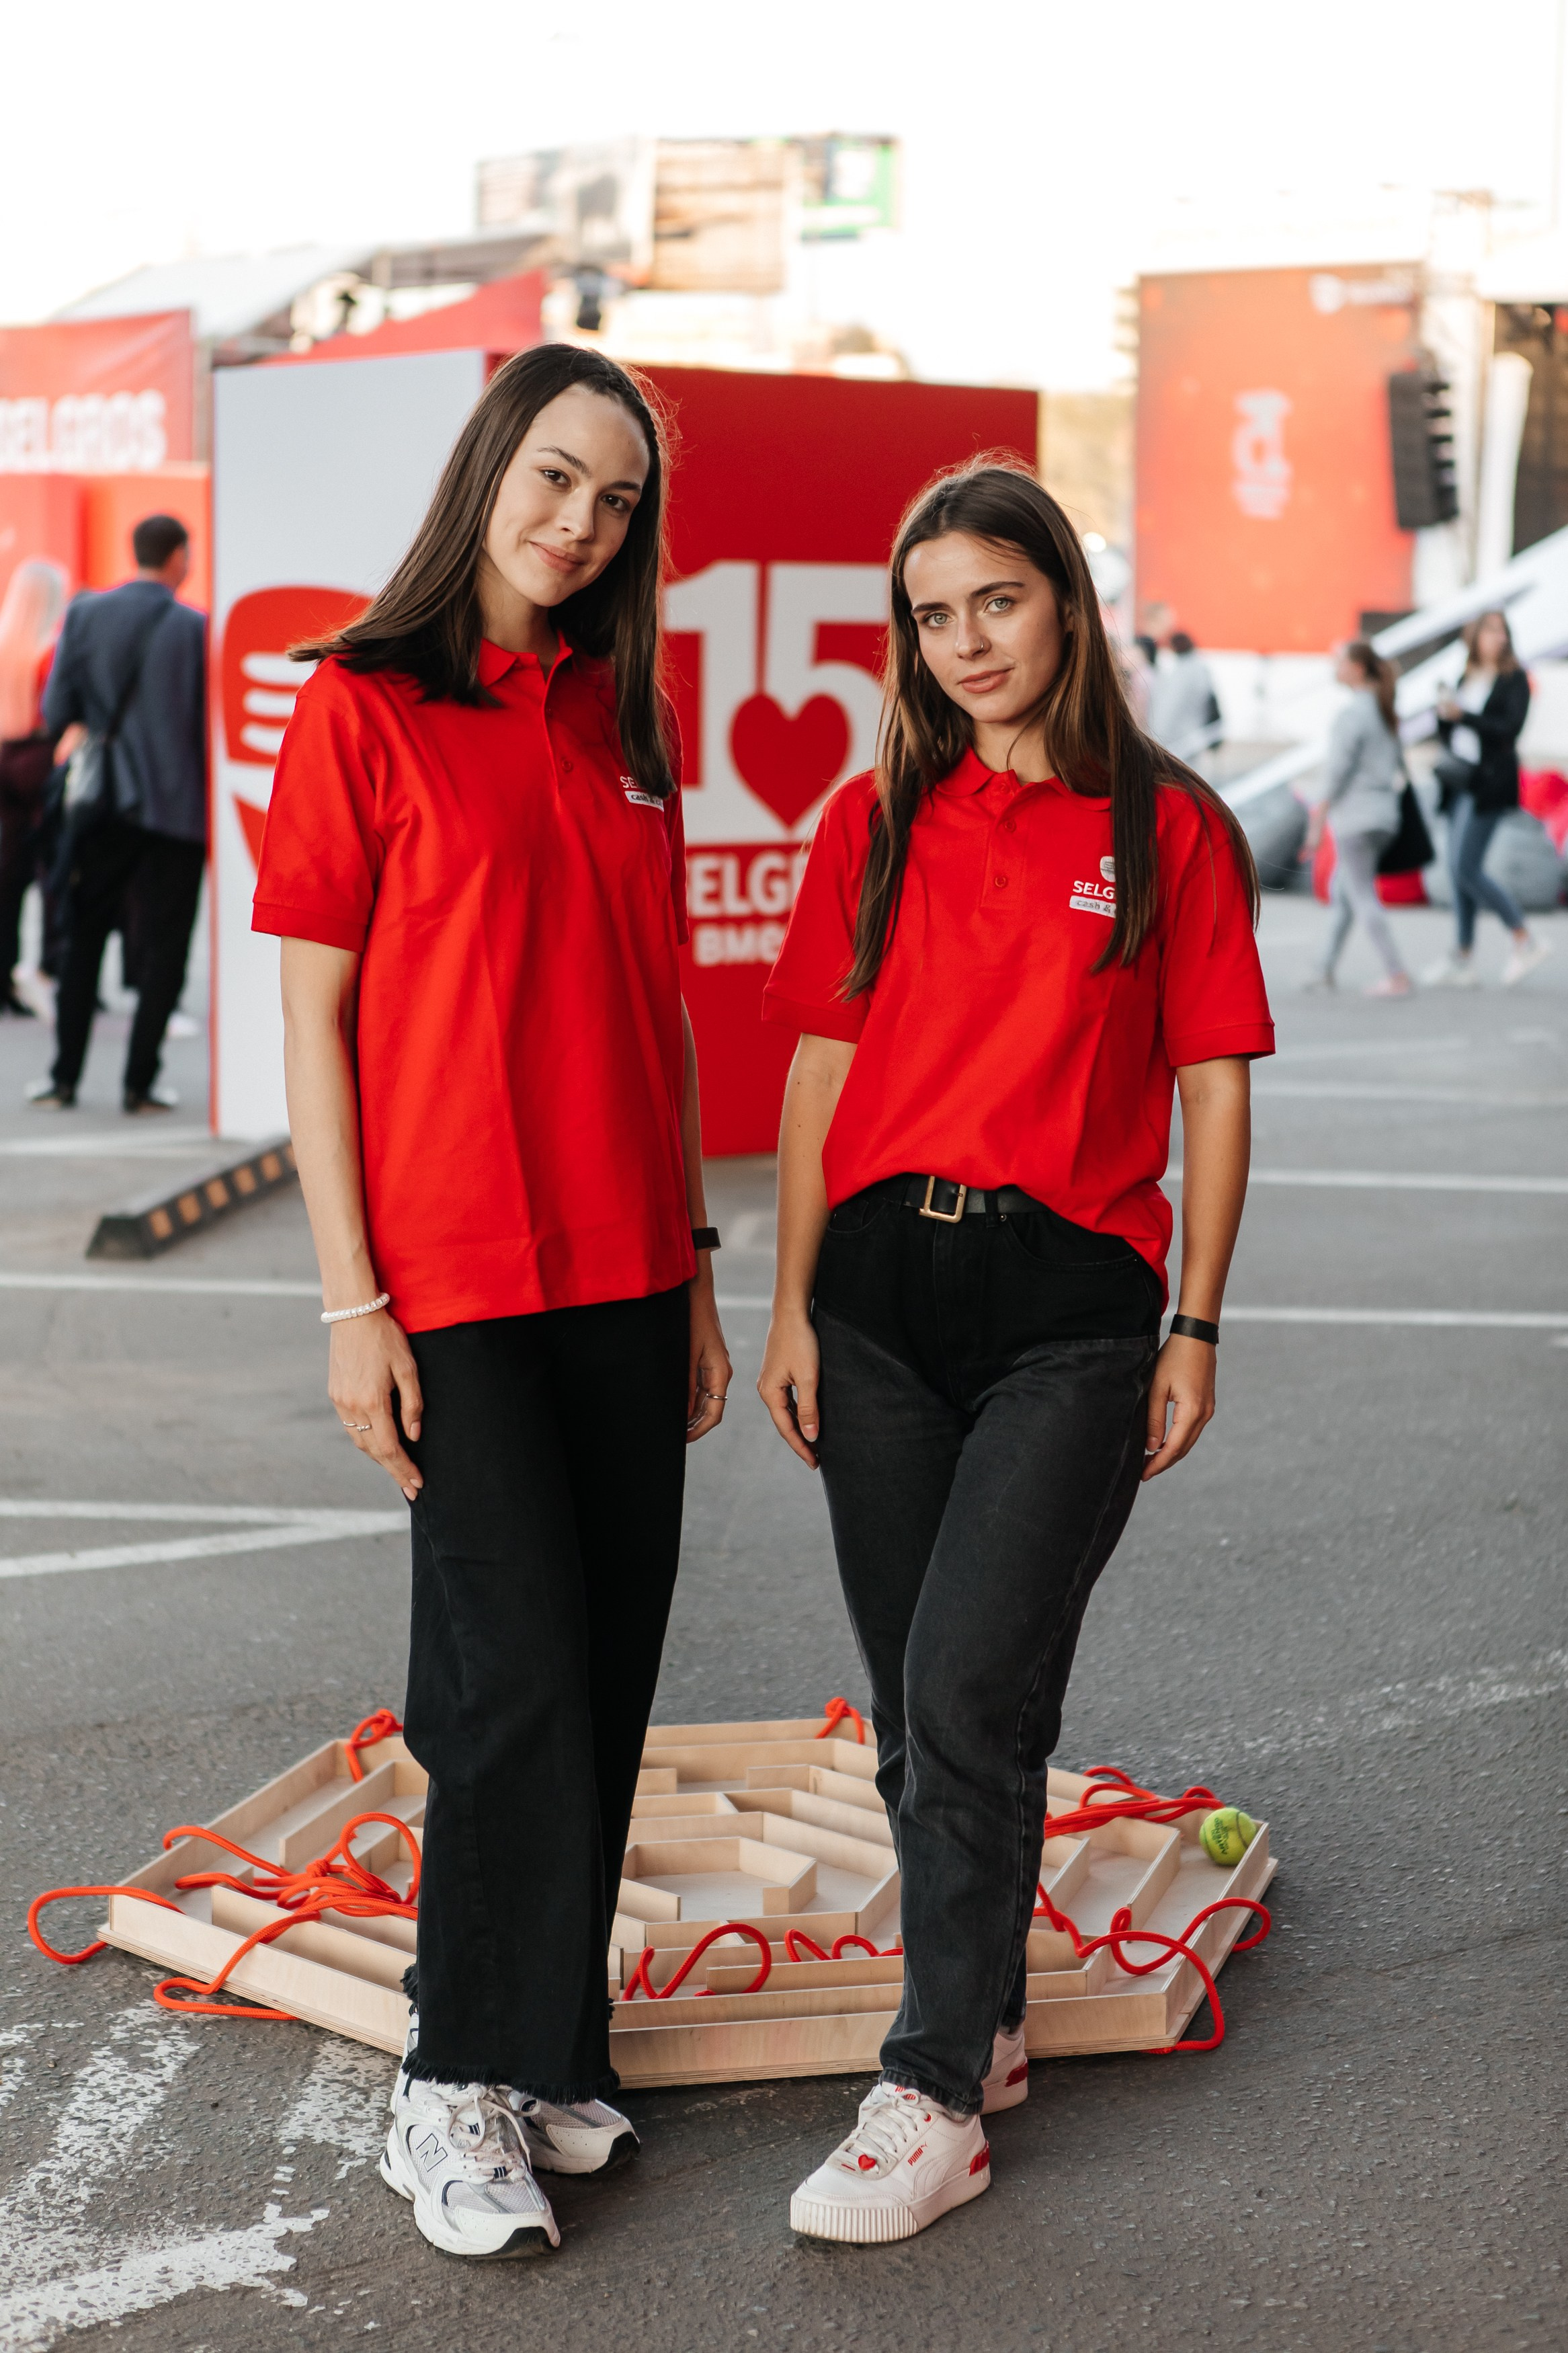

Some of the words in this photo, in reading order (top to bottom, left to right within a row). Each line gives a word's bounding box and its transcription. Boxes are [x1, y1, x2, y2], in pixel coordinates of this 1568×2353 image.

[662, 560, 891, 844] 15
[1072, 880, 1116, 900] SELG
[1077, 900, 1100, 910] cash
[1103, 904, 1111, 914] &
[416, 2132, 448, 2173] N
